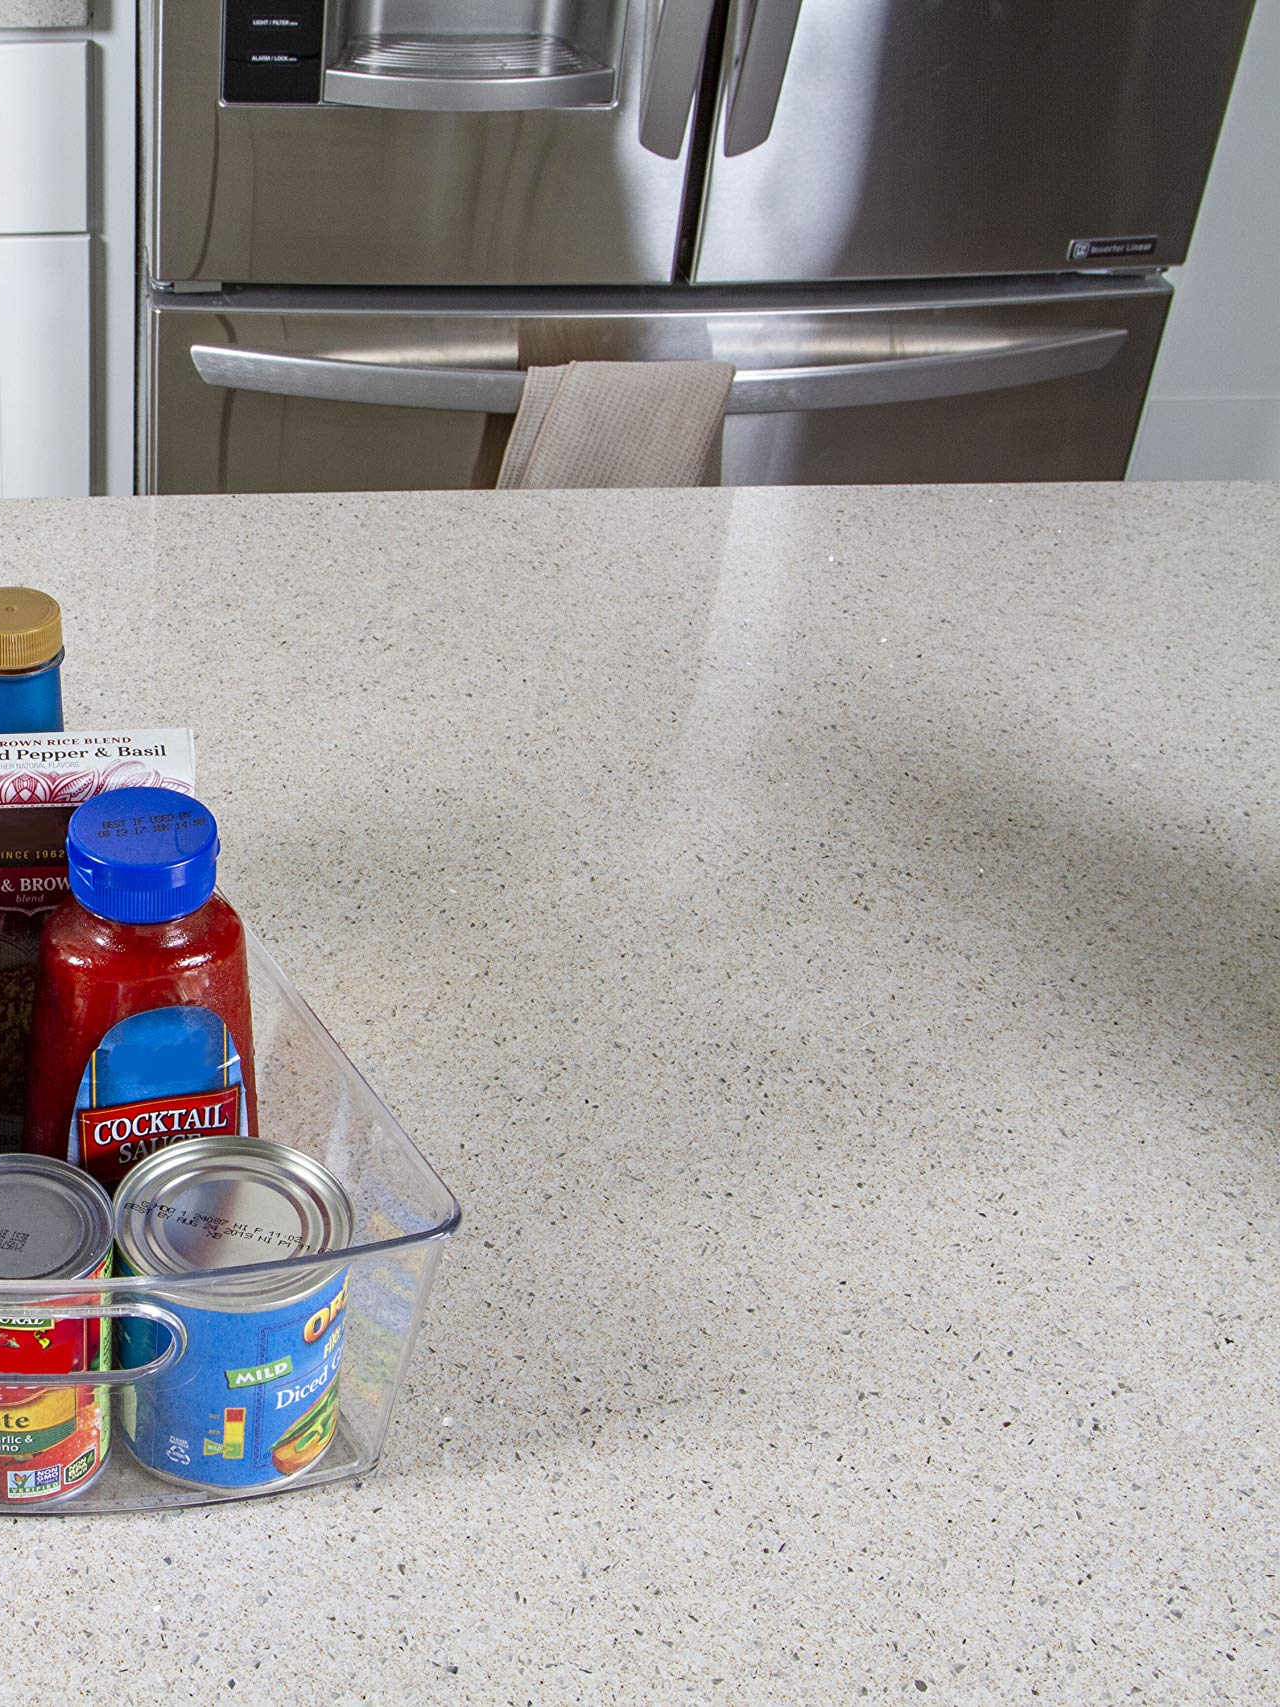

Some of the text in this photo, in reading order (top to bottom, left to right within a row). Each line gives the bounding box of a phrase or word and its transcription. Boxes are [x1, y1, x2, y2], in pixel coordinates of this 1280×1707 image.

[47, 738, 81, 747] RICE
[84, 736, 132, 746] BLEND
[18, 748, 88, 763] Pepper
[94, 746, 112, 758] &
[118, 744, 167, 758] Basil
[15, 762, 47, 770] NATURAL
[48, 761, 80, 769] FLAVORS
[102, 819, 126, 829] BEST
[35, 849, 66, 859] 1962
[0, 878, 16, 893] &
[15, 893, 45, 903] blend
[93, 1103, 229, 1147] COCKTAIL
[124, 1202, 152, 1216] BEST
[157, 1211, 171, 1220] BY
[176, 1216, 199, 1228] AUG
[202, 1222, 219, 1232] 24
[223, 1227, 254, 1240] 2019
[235, 1362, 289, 1385] MILD
[275, 1364, 329, 1410] Diced
[24, 1434, 34, 1444] &
[68, 1456, 87, 1472] NON
[36, 1466, 58, 1477] NON
[36, 1472, 59, 1482] GMO
[11, 1481, 60, 1494] VERIFIED
